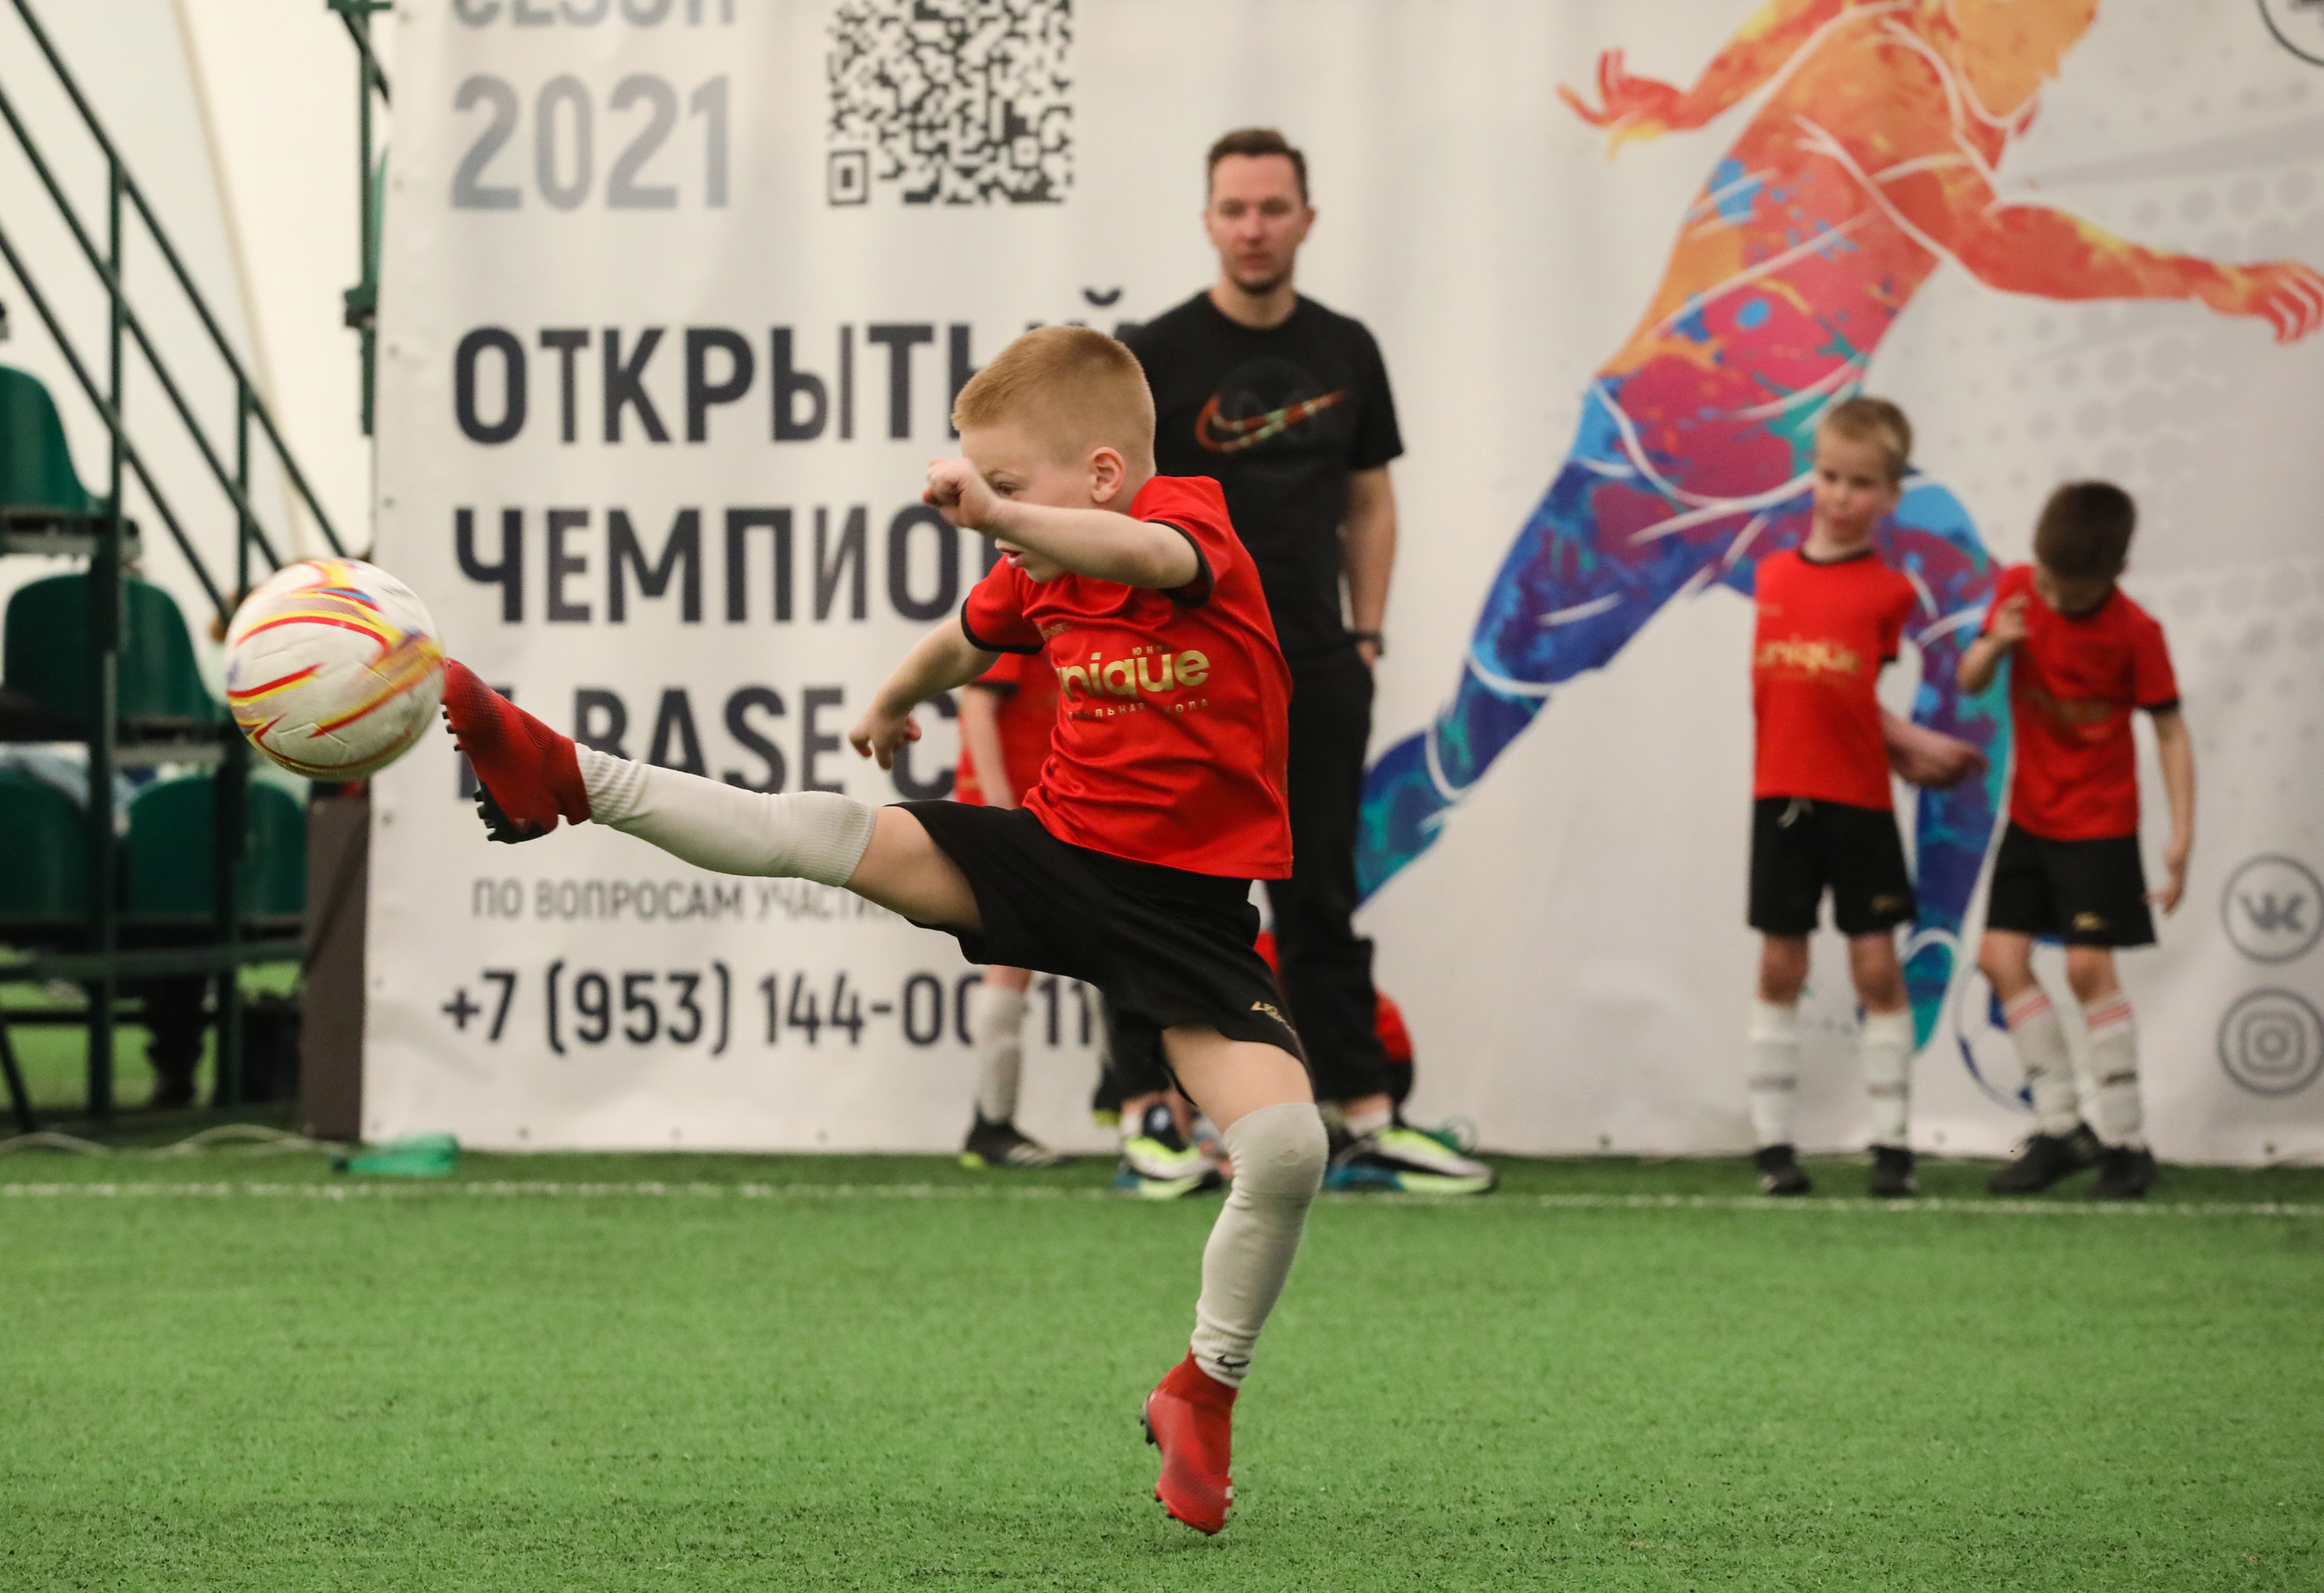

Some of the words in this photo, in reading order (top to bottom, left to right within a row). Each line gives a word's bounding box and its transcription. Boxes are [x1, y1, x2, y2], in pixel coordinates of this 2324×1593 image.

[448, 73, 729, 211] 2021
[454, 506, 997, 624] ЧЕМПИО
[472, 877, 524, 920] ПО
[535, 879, 743, 922] ВОПРОСАМ
[442, 971, 517, 1043] +7
[545, 959, 731, 1057] (953)
